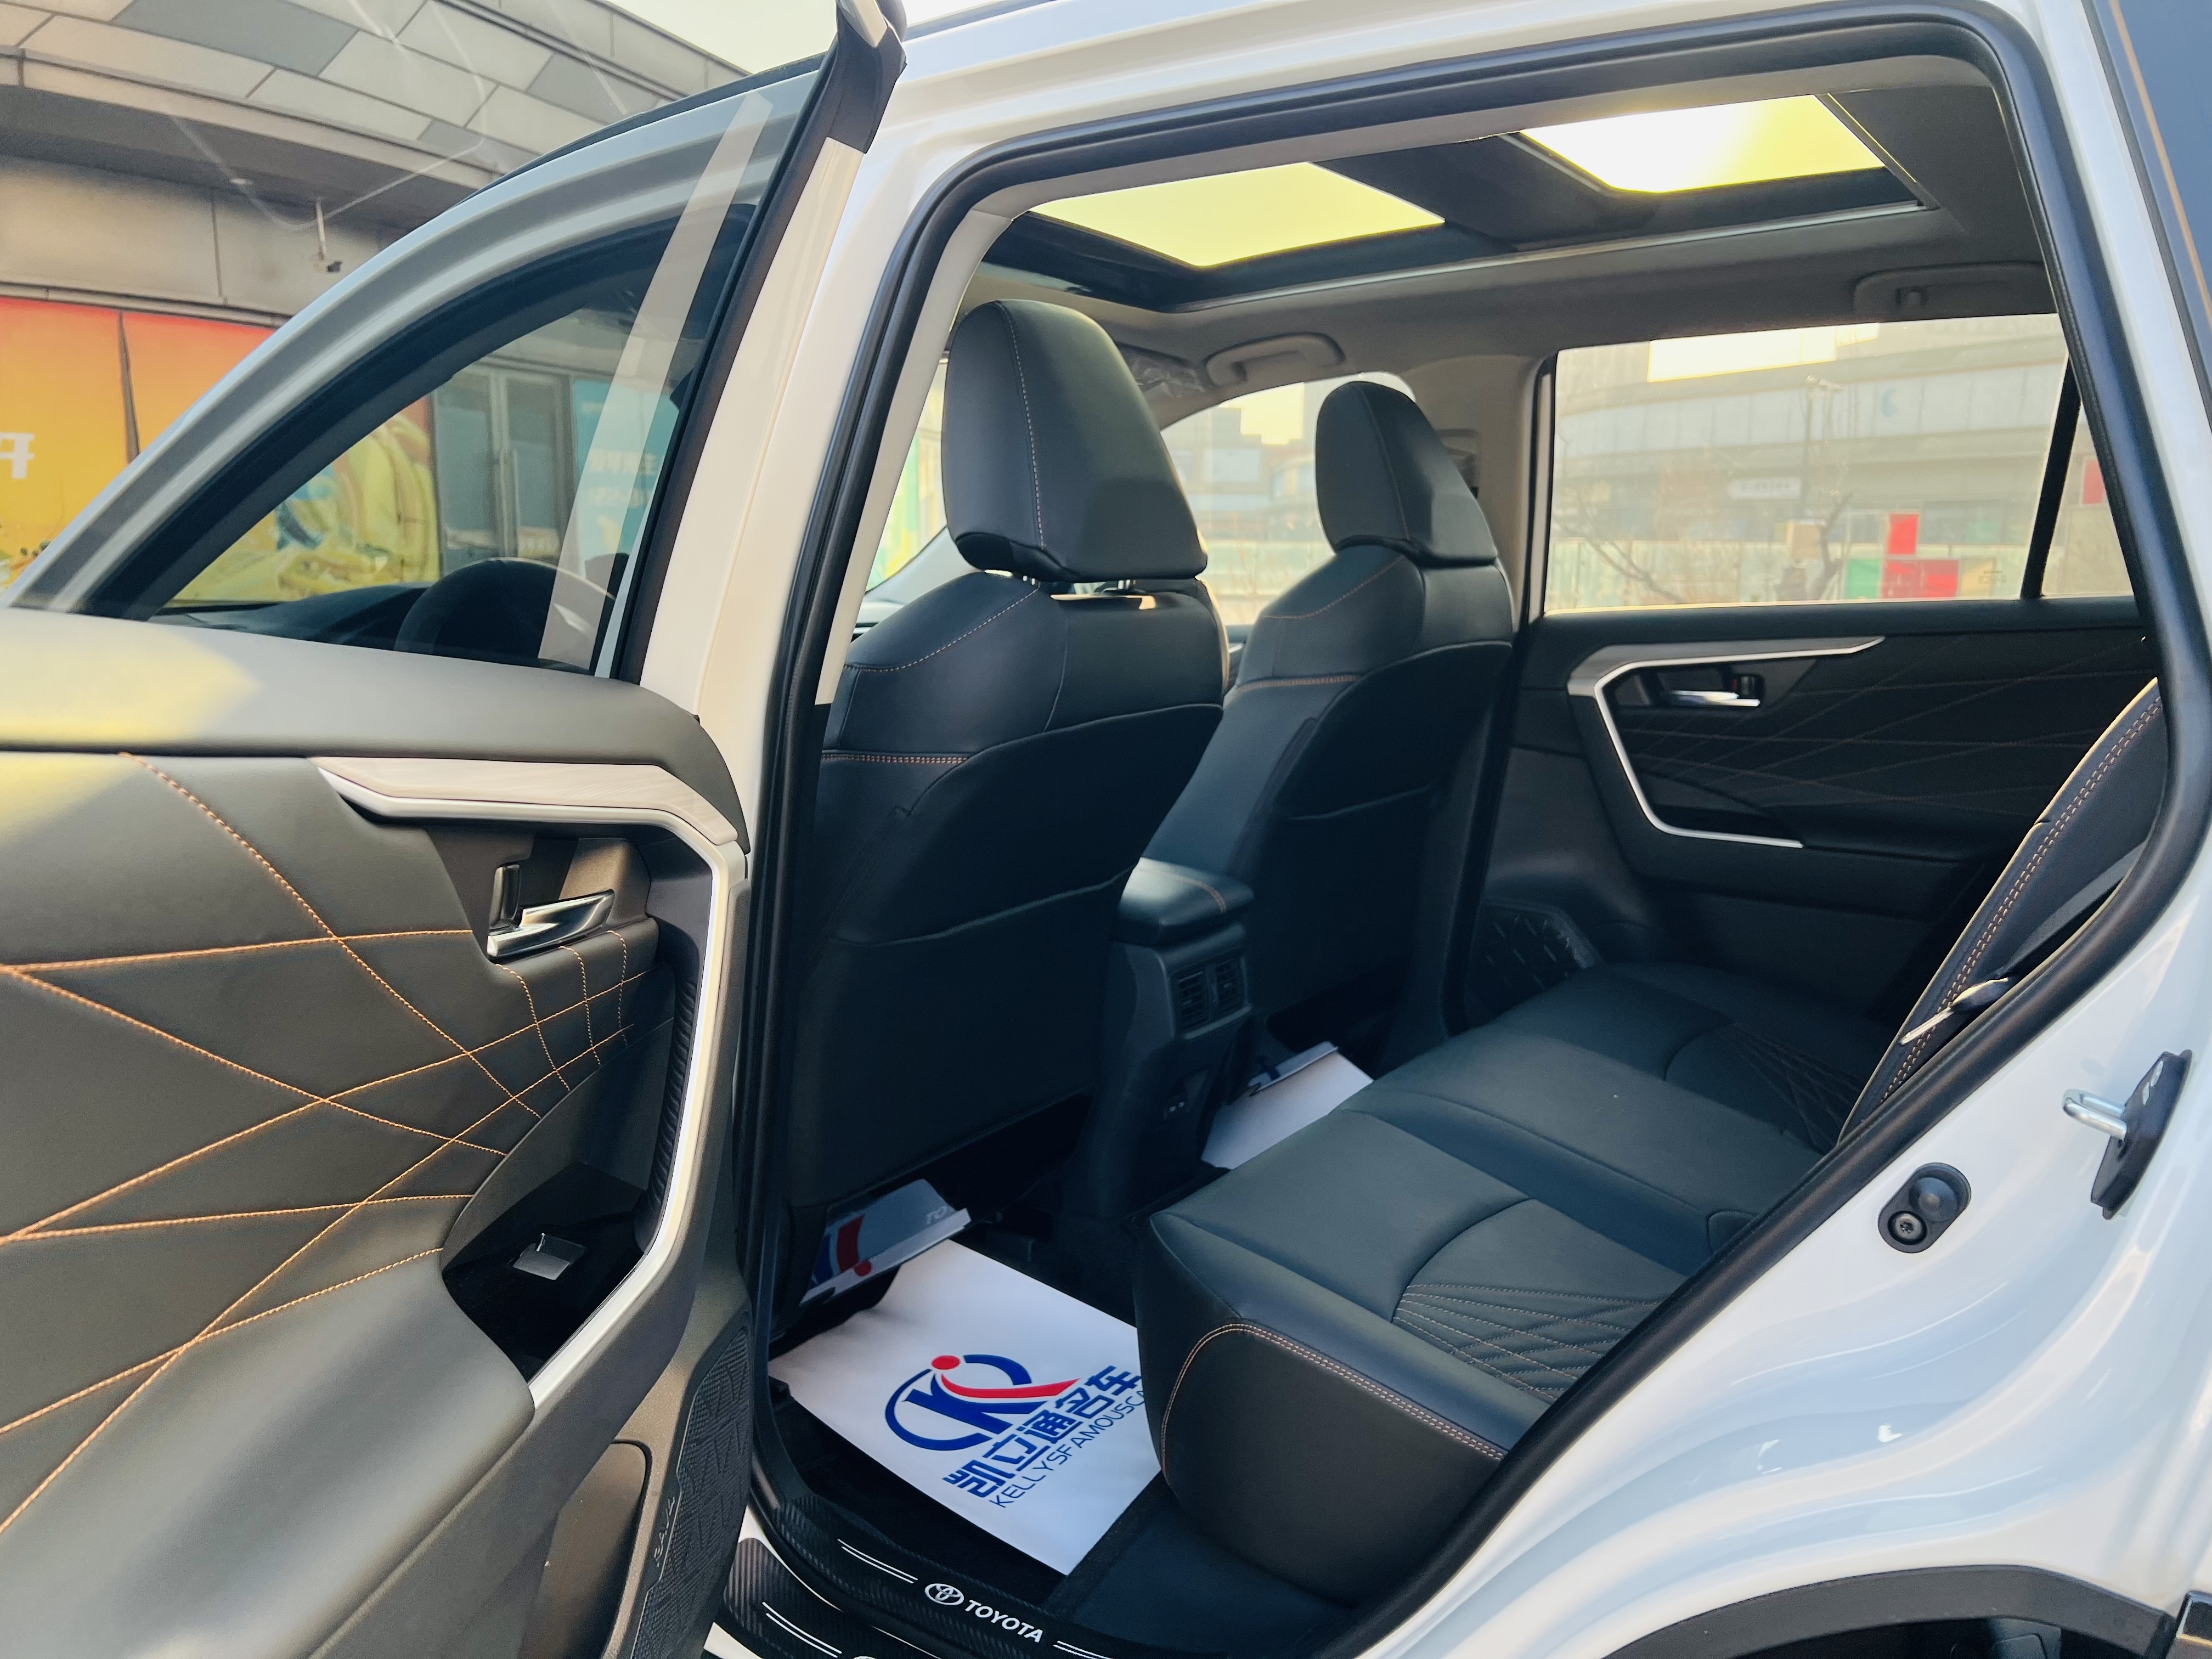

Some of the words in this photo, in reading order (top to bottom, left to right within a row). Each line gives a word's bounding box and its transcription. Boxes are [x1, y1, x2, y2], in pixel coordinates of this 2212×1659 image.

[942, 1365, 1142, 1498] 凯立通名车
[964, 1599, 1043, 1643] TOYOTA
